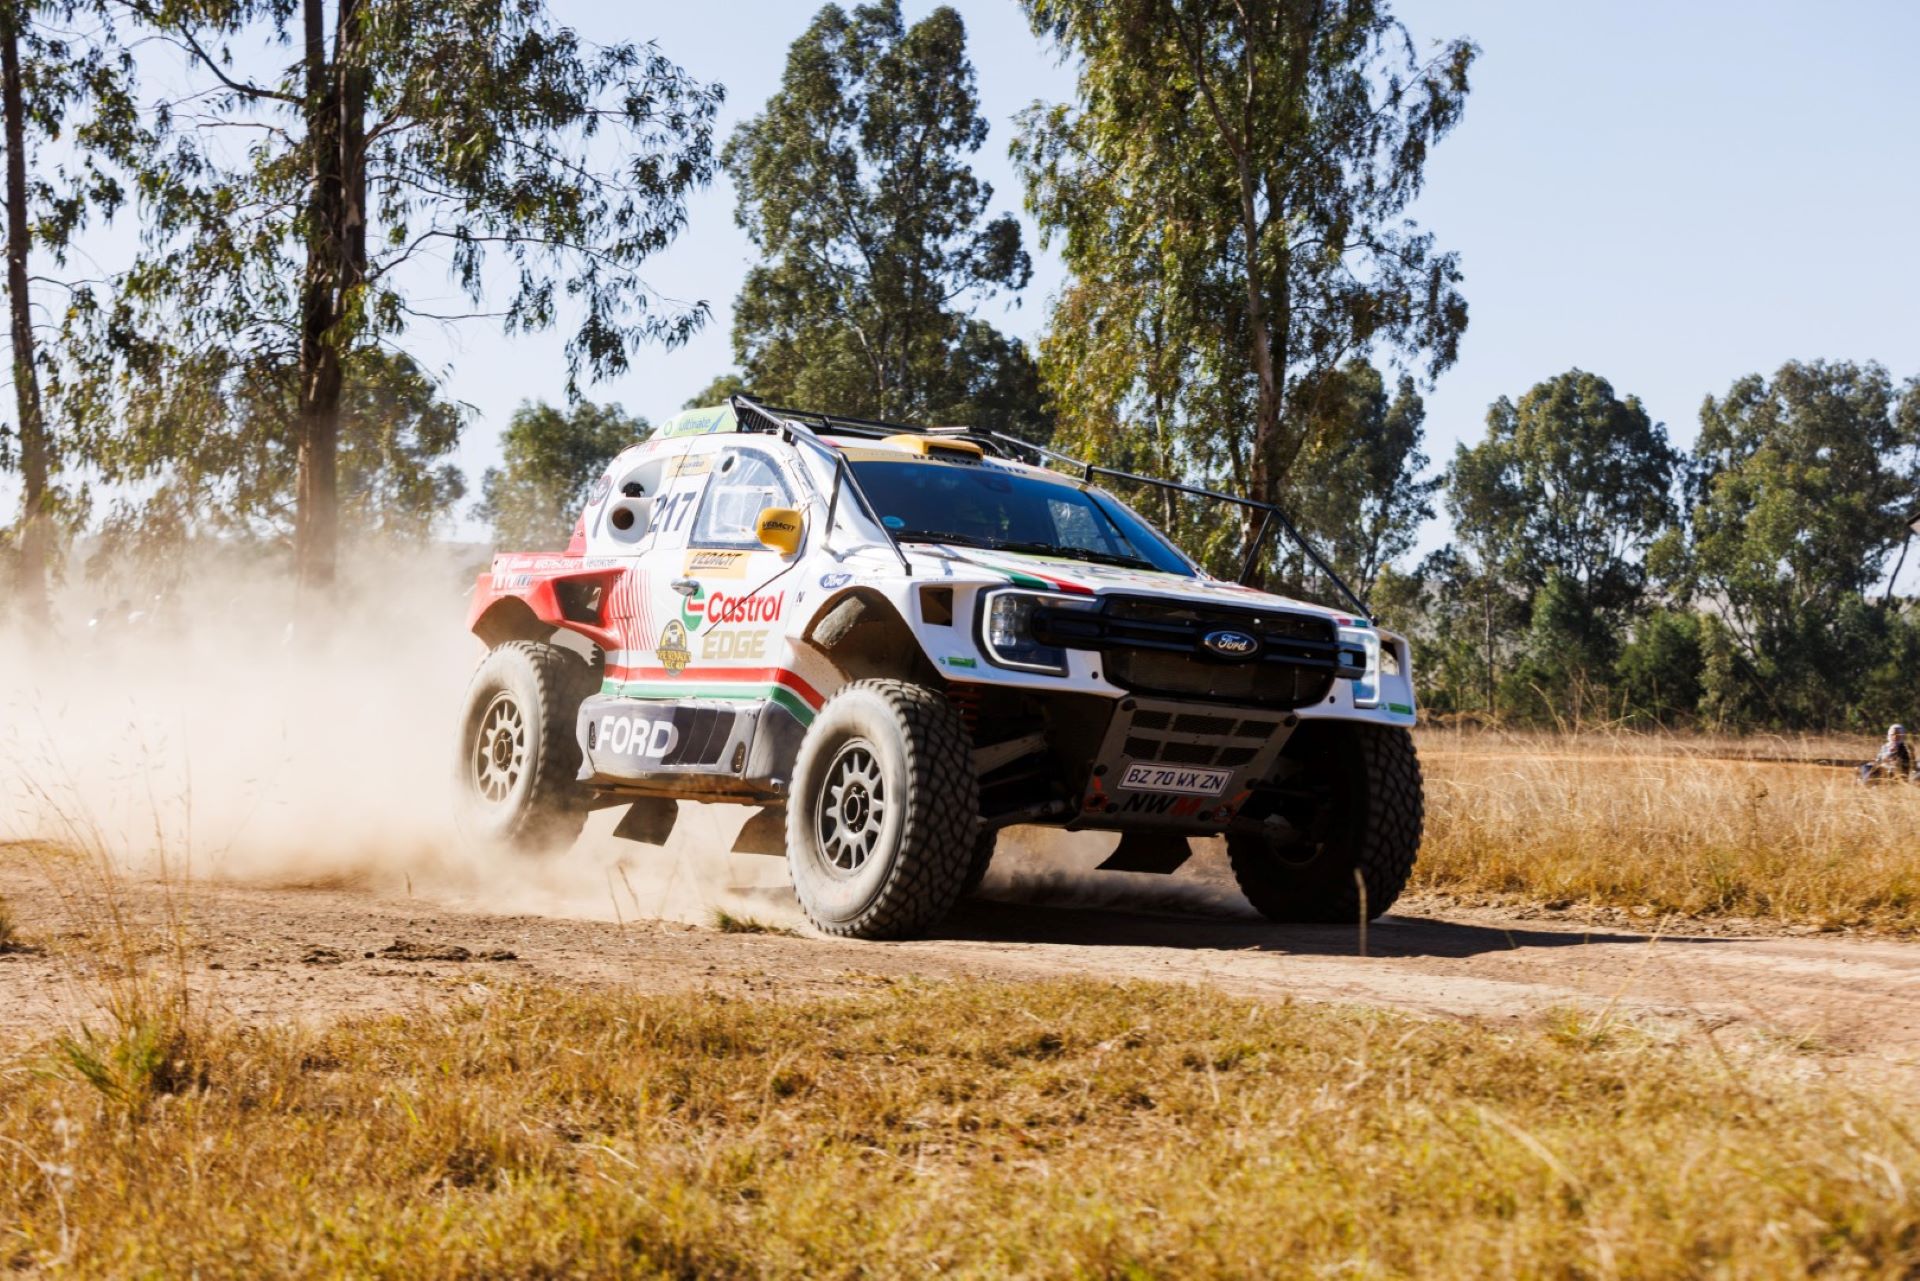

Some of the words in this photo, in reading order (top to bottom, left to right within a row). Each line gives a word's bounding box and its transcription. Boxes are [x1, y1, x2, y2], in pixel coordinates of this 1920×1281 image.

[648, 491, 697, 533] 217
[707, 589, 784, 623] Castrol
[702, 630, 768, 658] EDGE
[1218, 633, 1249, 651] Ford
[597, 715, 674, 759] FORD
[1128, 769, 1151, 784] BZ
[1153, 771, 1176, 786] 70
[1176, 772, 1200, 787] WX
[1200, 775, 1225, 790] ZN
[1122, 794, 1202, 816] NWM
